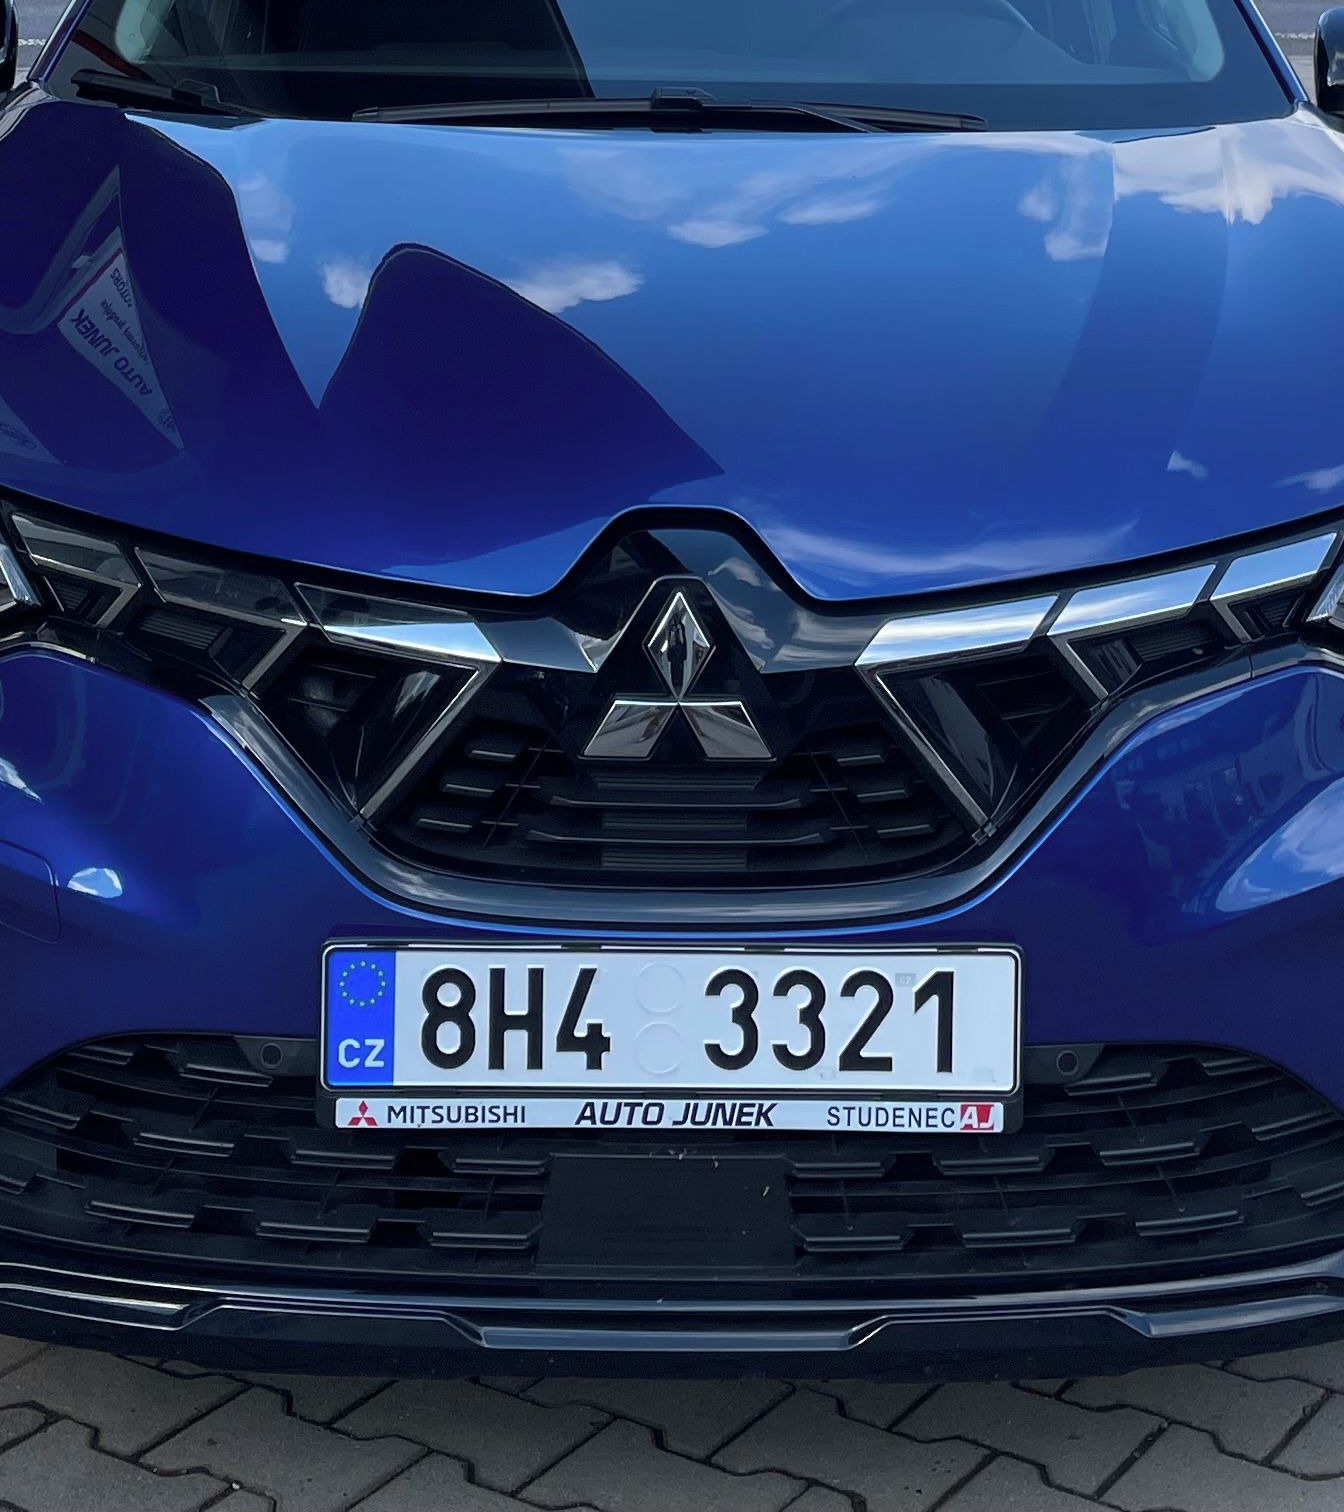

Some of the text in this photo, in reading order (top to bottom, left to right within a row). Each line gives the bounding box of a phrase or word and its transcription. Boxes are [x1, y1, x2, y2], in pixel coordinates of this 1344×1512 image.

[420, 968, 957, 1074] 8H4 3321
[338, 1038, 386, 1068] CZ
[387, 1105, 527, 1124] MITSUBISHI
[574, 1101, 665, 1126] AUTO
[672, 1102, 778, 1127] JUNEK
[827, 1106, 955, 1129] STUDENEC
